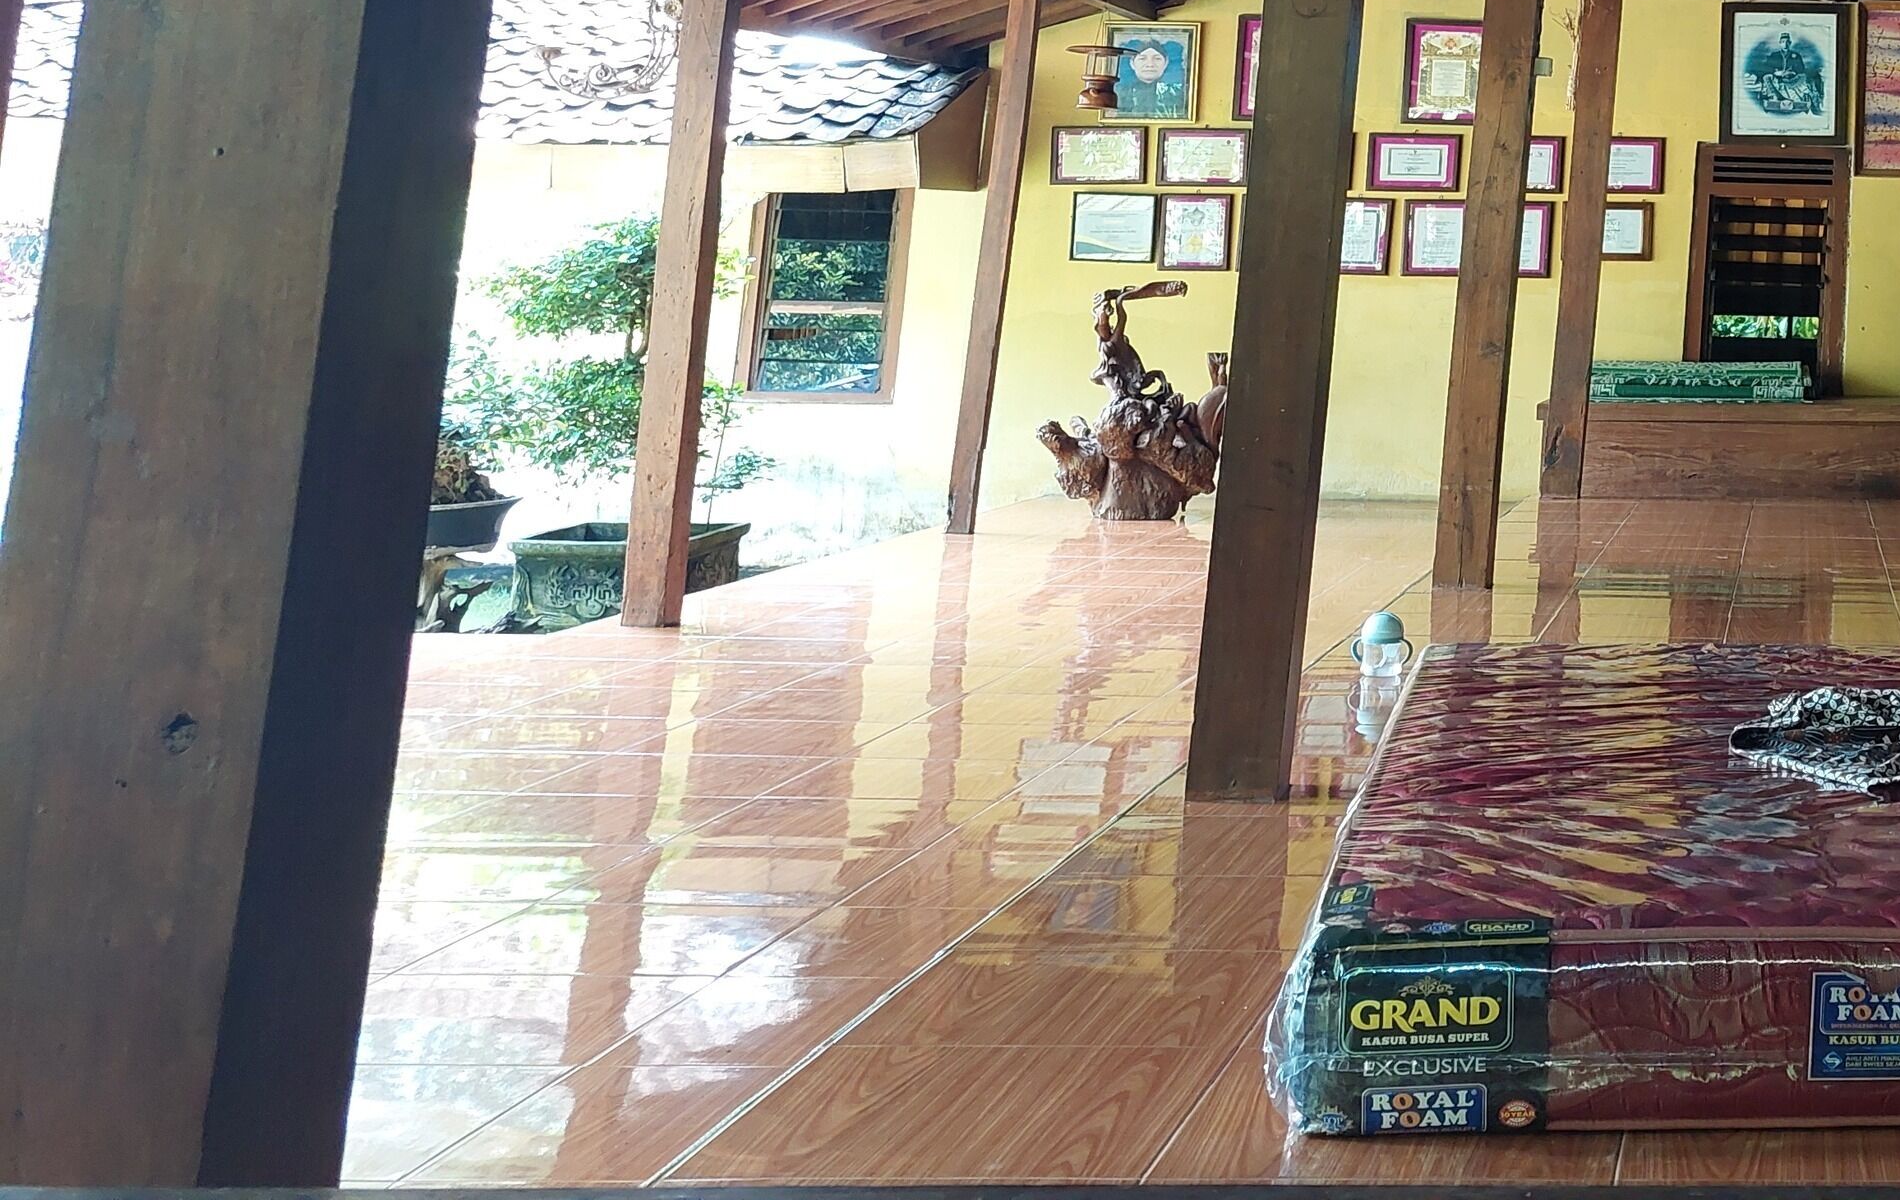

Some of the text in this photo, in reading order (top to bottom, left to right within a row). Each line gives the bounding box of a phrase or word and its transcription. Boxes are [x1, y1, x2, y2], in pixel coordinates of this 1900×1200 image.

[1351, 996, 1500, 1033] GRAND
[1361, 1032, 1490, 1046] KASUR BUSA SUPER
[1828, 1035, 1877, 1045] KASUR
[1363, 1057, 1487, 1077] EXCLUSIVE
[1371, 1090, 1474, 1111] ROYAL
[1380, 1109, 1468, 1129] FOAM
